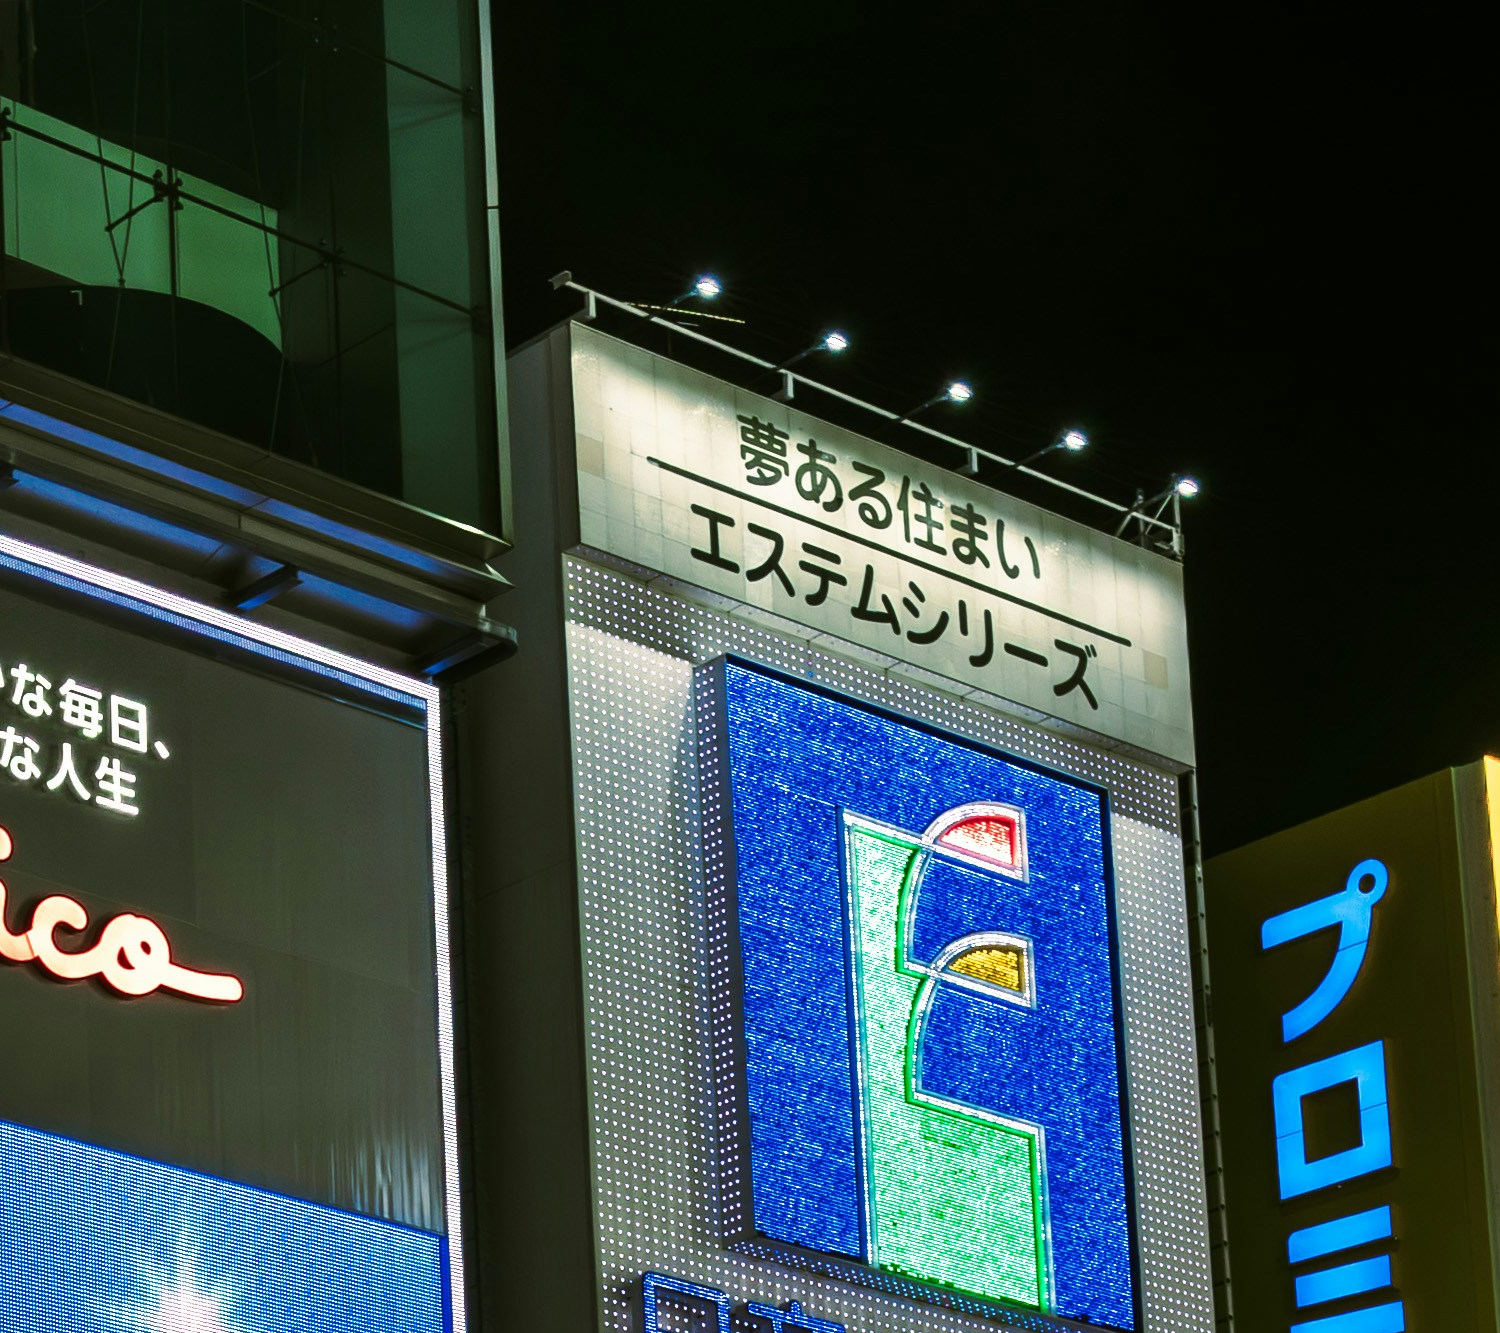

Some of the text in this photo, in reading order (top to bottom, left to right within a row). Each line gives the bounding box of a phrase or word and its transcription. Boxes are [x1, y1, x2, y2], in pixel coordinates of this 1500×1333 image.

[736, 412, 1042, 581] 夢ある住まい
[690, 502, 1099, 712] エステムシリーズ
